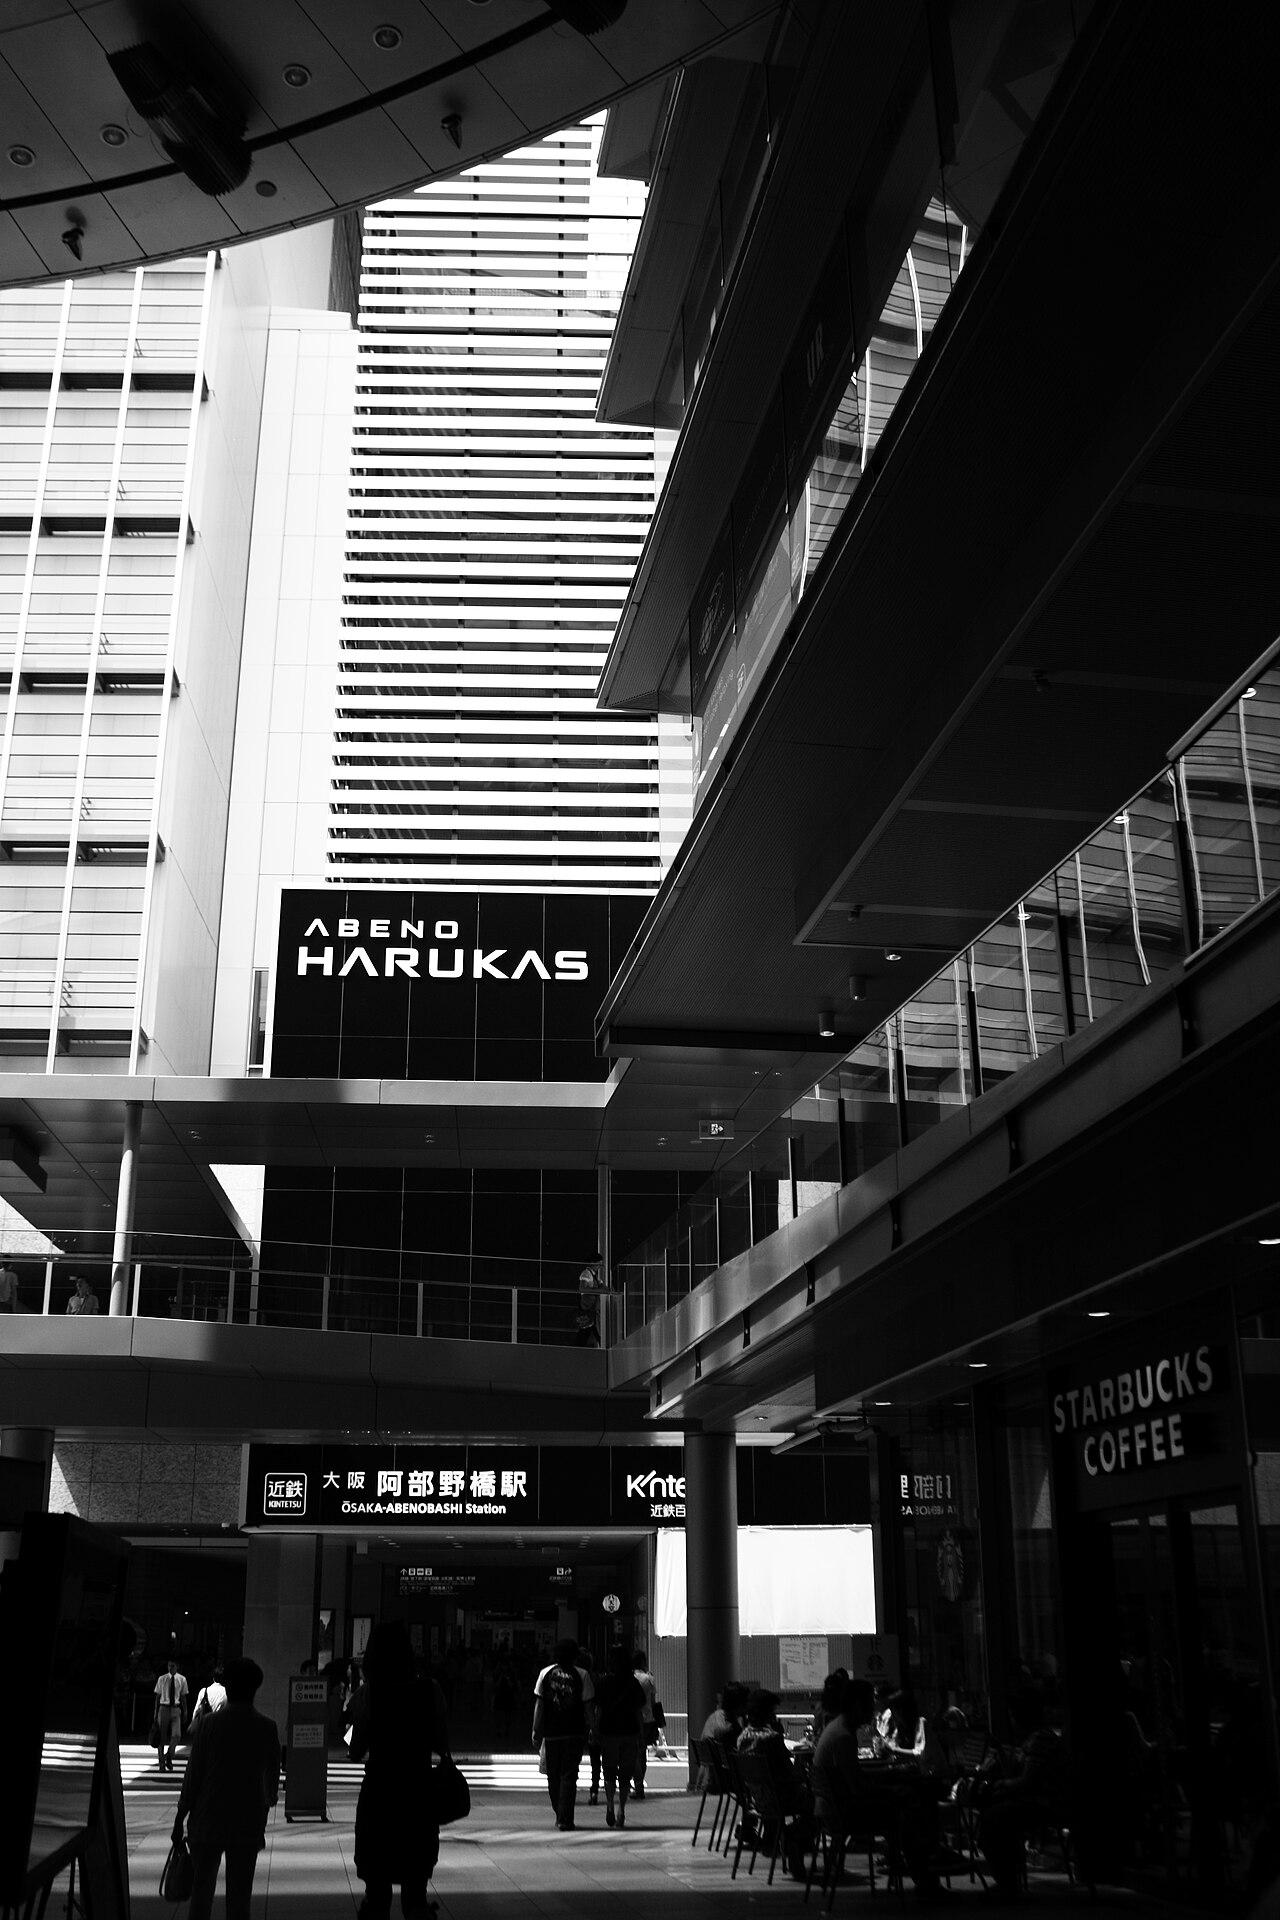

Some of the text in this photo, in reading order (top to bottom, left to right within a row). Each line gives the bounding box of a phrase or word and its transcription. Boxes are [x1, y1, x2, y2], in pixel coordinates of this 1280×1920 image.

[303, 917, 459, 940] ABENO
[297, 946, 589, 981] HARUKAS
[1053, 1345, 1214, 1434] STARBUCKS
[1084, 1412, 1186, 1477] COFFEE
[268, 1480, 304, 1498] 近鉄
[376, 1470, 527, 1498] 阿部野橋駅
[268, 1500, 302, 1509] KINTETSU
[465, 1503, 507, 1515] Station
